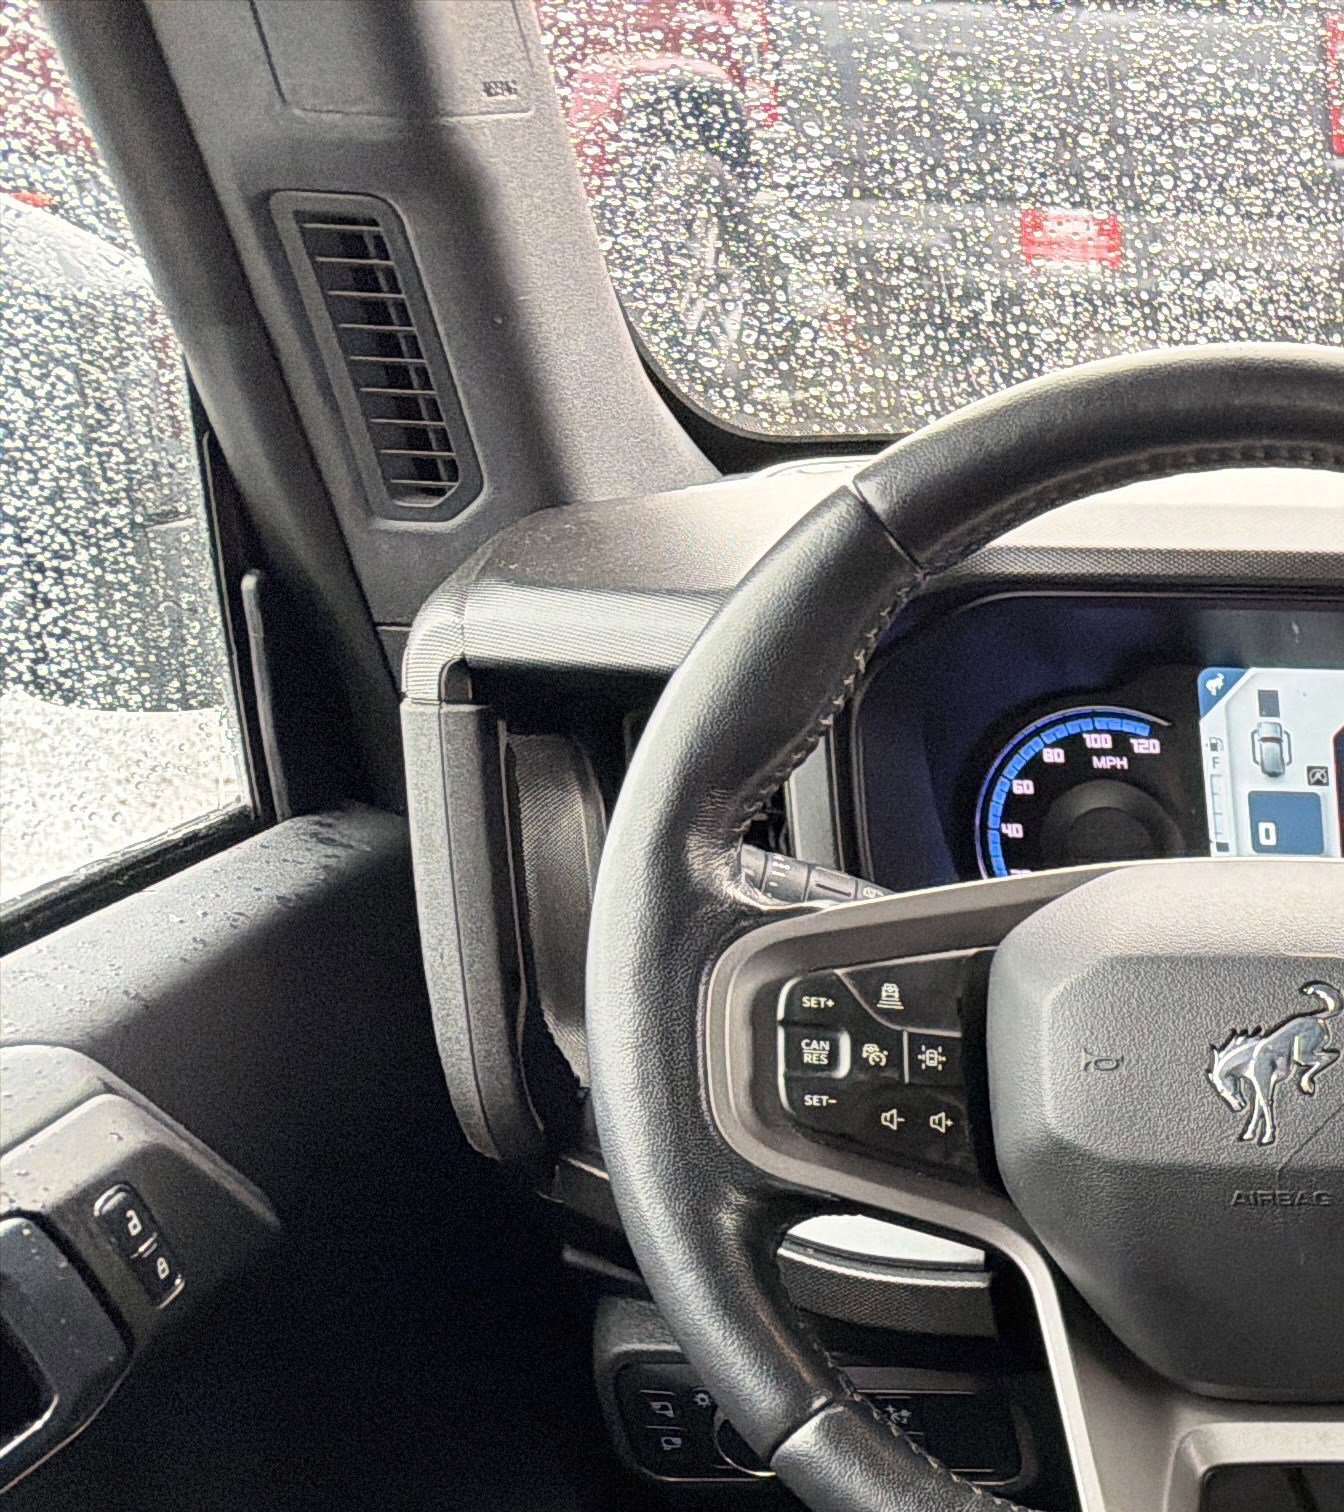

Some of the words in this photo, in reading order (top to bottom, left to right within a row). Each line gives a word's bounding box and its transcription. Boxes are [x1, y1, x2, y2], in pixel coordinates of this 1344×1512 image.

[1082, 733, 1112, 749] 100
[1130, 738, 1161, 754] 120
[1042, 748, 1065, 763] 80
[1092, 756, 1128, 769] MPH
[1212, 756, 1221, 768] F
[1012, 780, 1034, 794] 60
[1001, 823, 1024, 838] 40
[802, 997, 835, 1009] SET+
[801, 1039, 830, 1051] CAN
[804, 1053, 829, 1065] RES
[1231, 1190, 1332, 1207] AIRBAG
